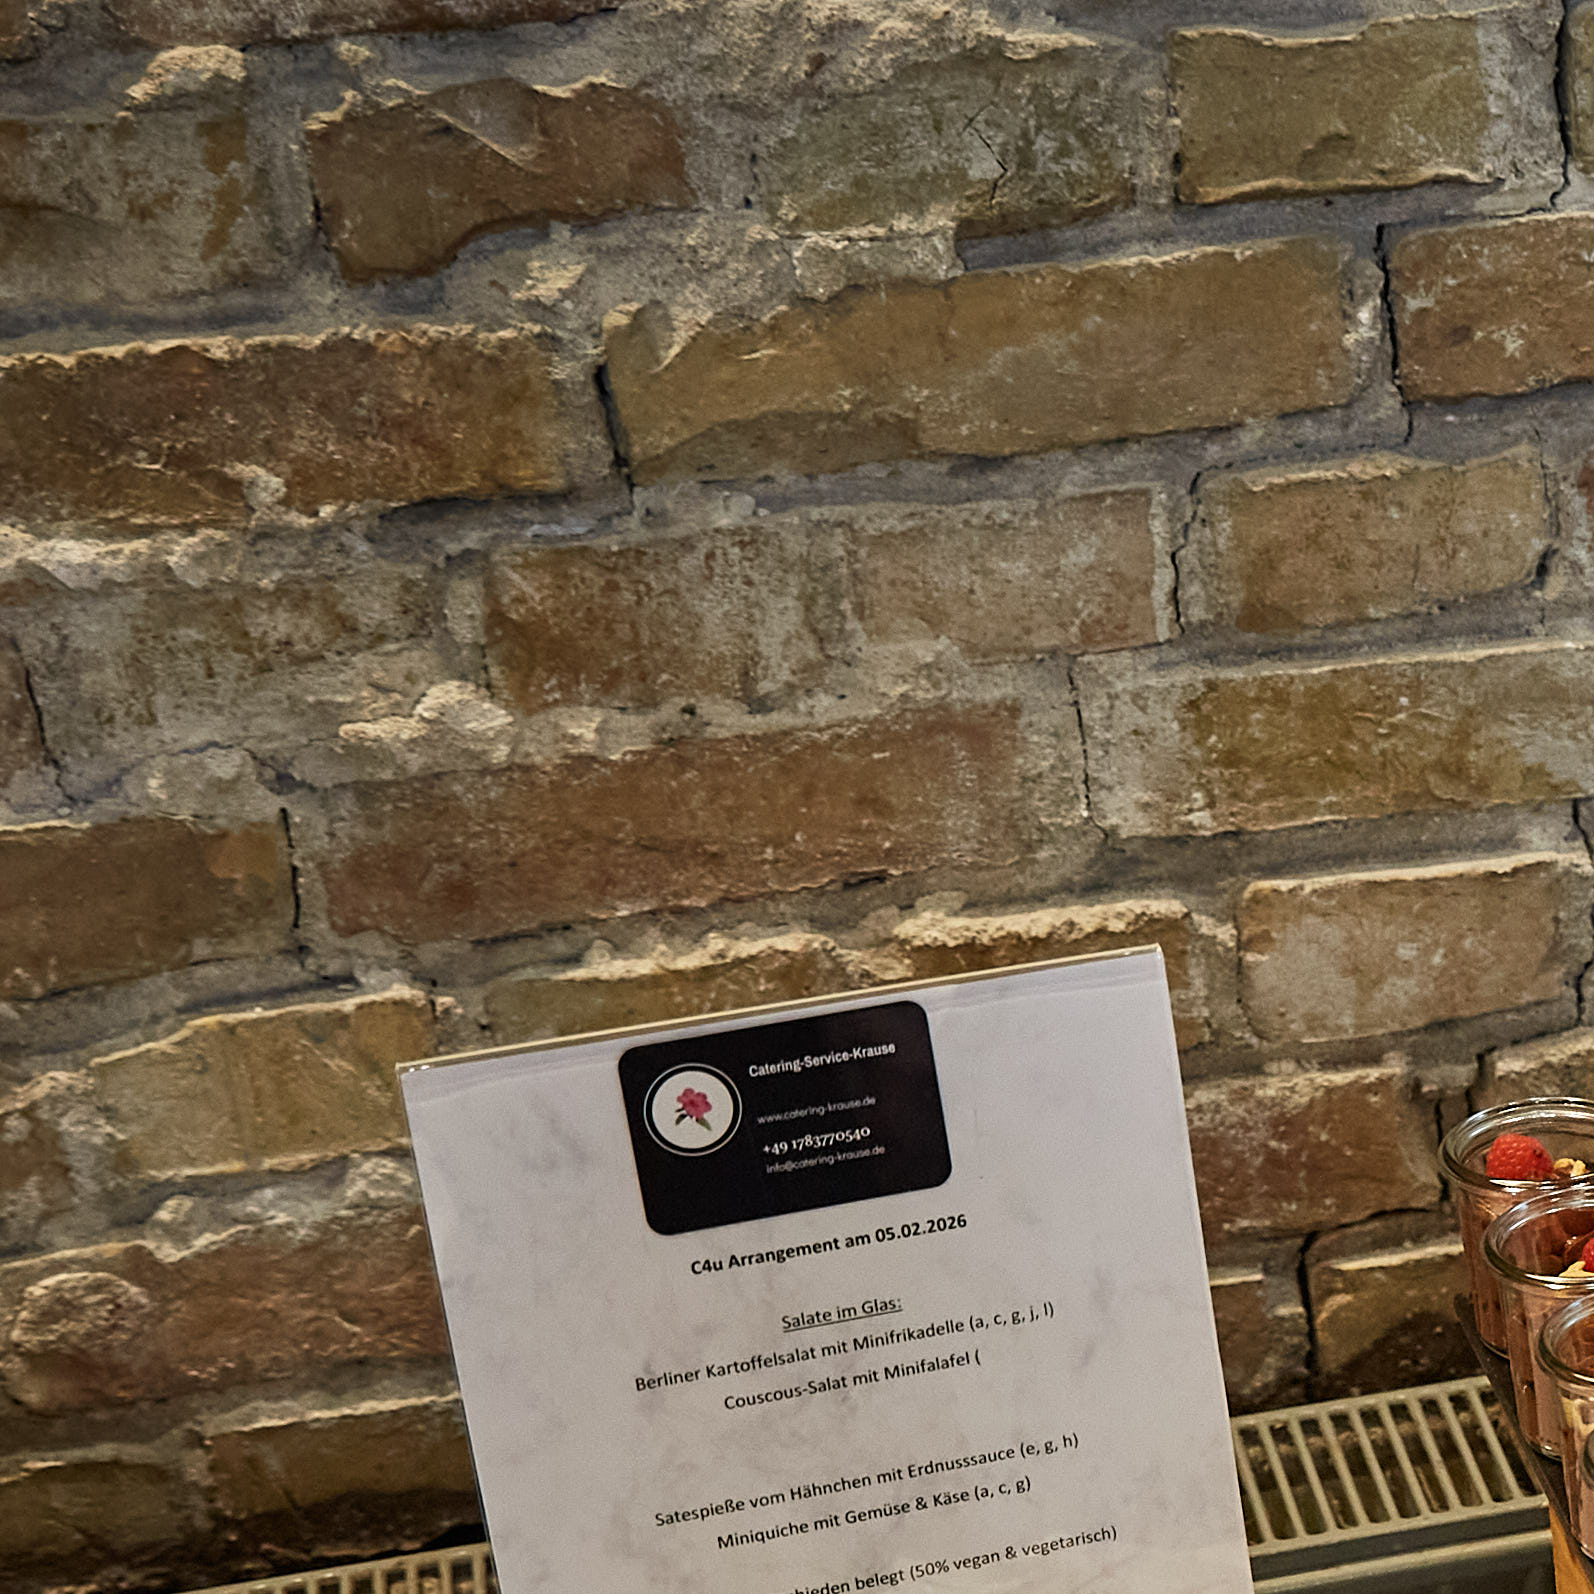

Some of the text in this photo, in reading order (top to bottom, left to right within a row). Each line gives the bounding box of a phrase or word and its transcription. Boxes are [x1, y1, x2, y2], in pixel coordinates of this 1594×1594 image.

[747, 1042, 896, 1077] Catering-Service-Krause
[762, 1125, 871, 1155] +49 1783770540
[689, 1257, 724, 1275] C4u
[727, 1236, 841, 1269] Arrangement
[873, 1212, 967, 1243] 05.02.2026
[780, 1309, 832, 1332] Salate
[860, 1297, 903, 1315] Glas:
[634, 1368, 701, 1392] Berliner
[704, 1345, 817, 1379] Kartoffelsalat
[820, 1339, 849, 1358] mit
[851, 1318, 965, 1352] Minifrikadelle
[968, 1314, 989, 1333] (a,
[722, 1374, 848, 1410] Couscous-Salat
[851, 1368, 880, 1387] mit
[882, 1350, 971, 1380] Minifalafel
[653, 1497, 745, 1527] Satespieße
[747, 1491, 786, 1509] vom
[788, 1474, 872, 1501] Hähnchen
[875, 1467, 904, 1484] mit
[906, 1447, 1016, 1479] Erdnusssauce
[1018, 1440, 1041, 1460] (e,
[716, 1521, 809, 1550] Miniquiche
[812, 1513, 841, 1531] mit
[843, 1501, 911, 1525] Gemüse
[914, 1495, 929, 1511] &
[931, 1490, 970, 1508] Käse
[973, 1484, 995, 1502] (a,
[853, 1568, 905, 1591] belegt
[908, 1557, 950, 1582] (50%
[951, 1551, 1001, 1570] vegan
[1004, 1544, 1018, 1560] &
[1020, 1524, 1117, 1557] vegetarisch)
